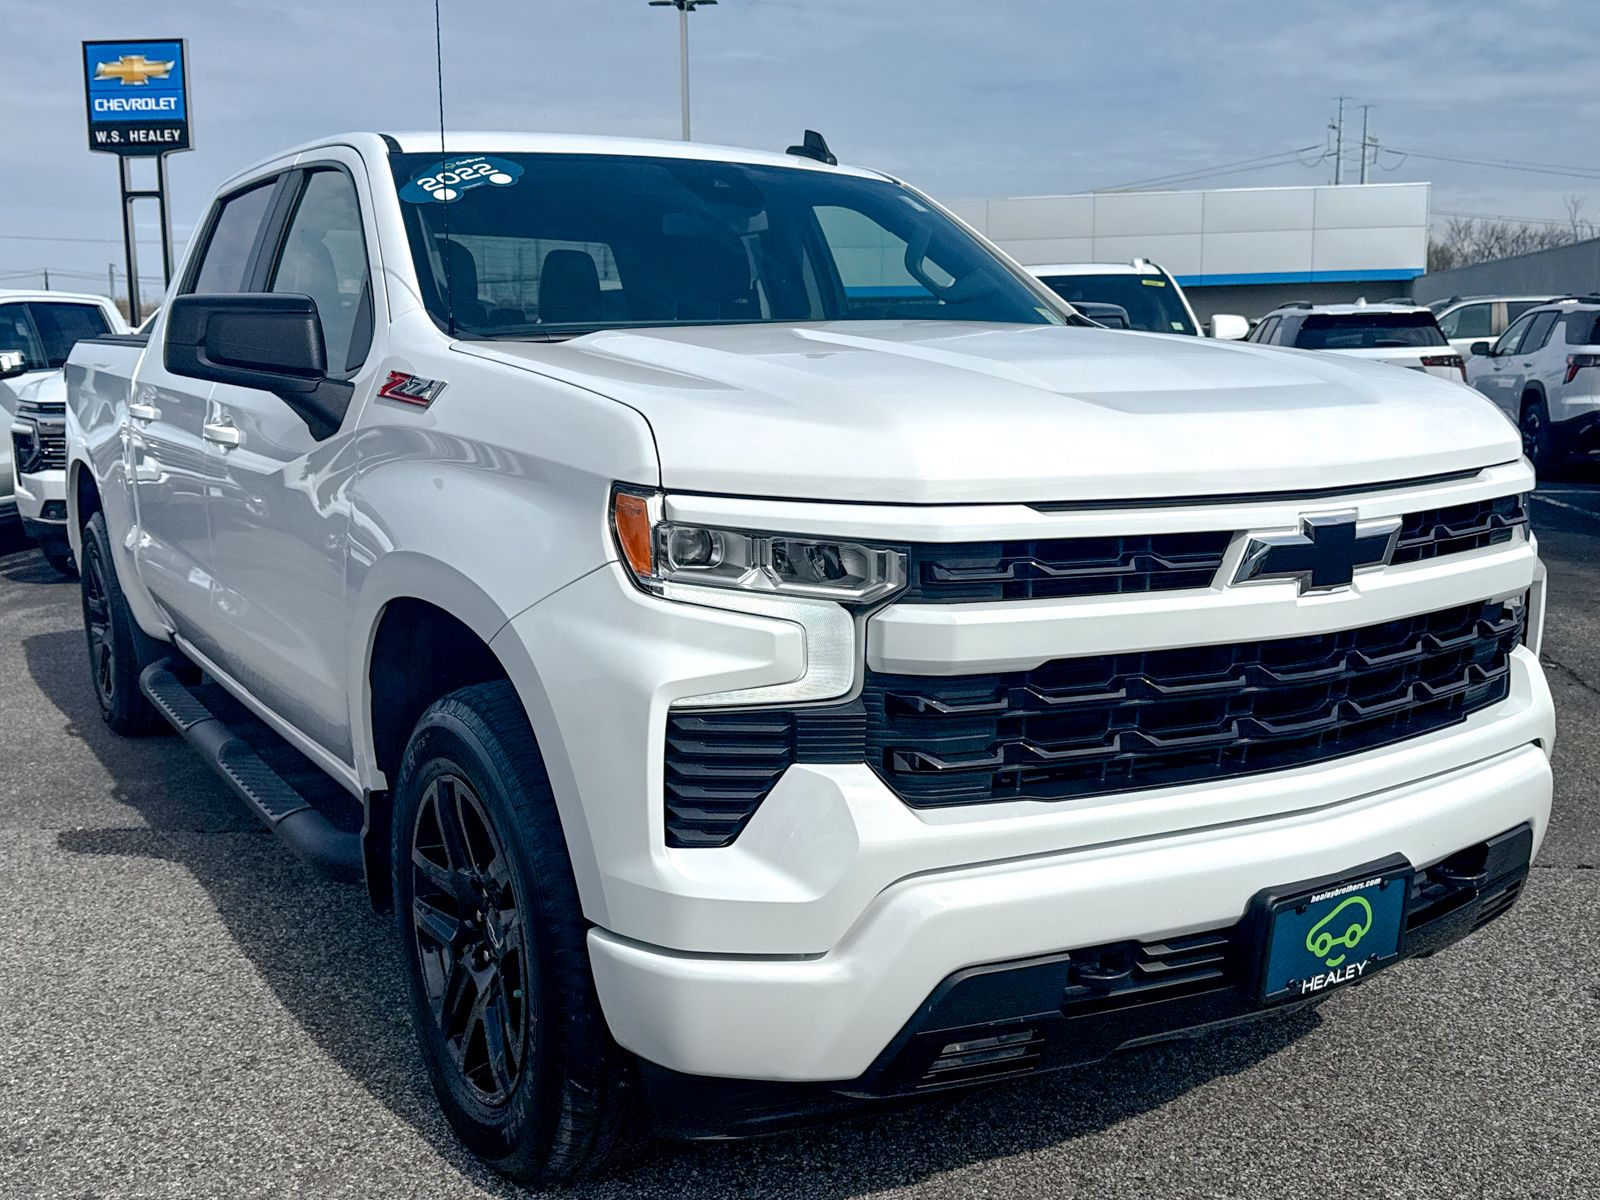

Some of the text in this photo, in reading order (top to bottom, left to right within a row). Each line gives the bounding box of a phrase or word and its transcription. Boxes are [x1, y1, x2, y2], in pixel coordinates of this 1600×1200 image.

[94, 97, 177, 112] CHEVROLET
[95, 129, 181, 143] W.S. HEALEY
[417, 163, 499, 192] 2022
[377, 370, 448, 409] Z71
[1310, 877, 1382, 904] healeybrothers.com
[1301, 960, 1367, 994] HEALEY
